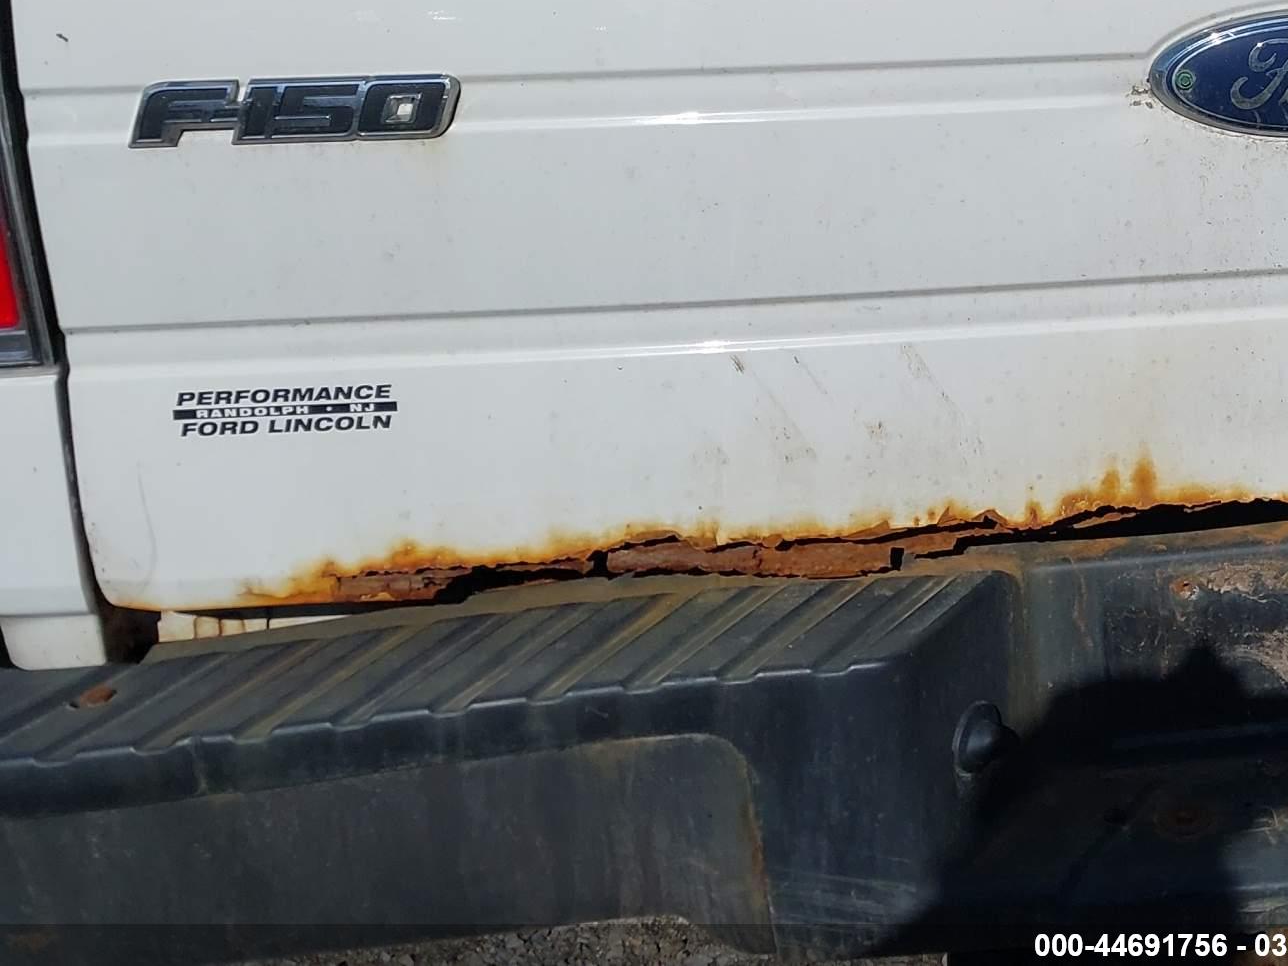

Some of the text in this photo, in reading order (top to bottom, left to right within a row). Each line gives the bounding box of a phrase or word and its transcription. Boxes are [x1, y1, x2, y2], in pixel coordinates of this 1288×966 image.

[128, 73, 461, 149] F-150
[176, 384, 392, 406] PERFORMANCE
[196, 402, 375, 419] RANDOLPH NJ
[181, 414, 392, 437] FORD LINCOLN
